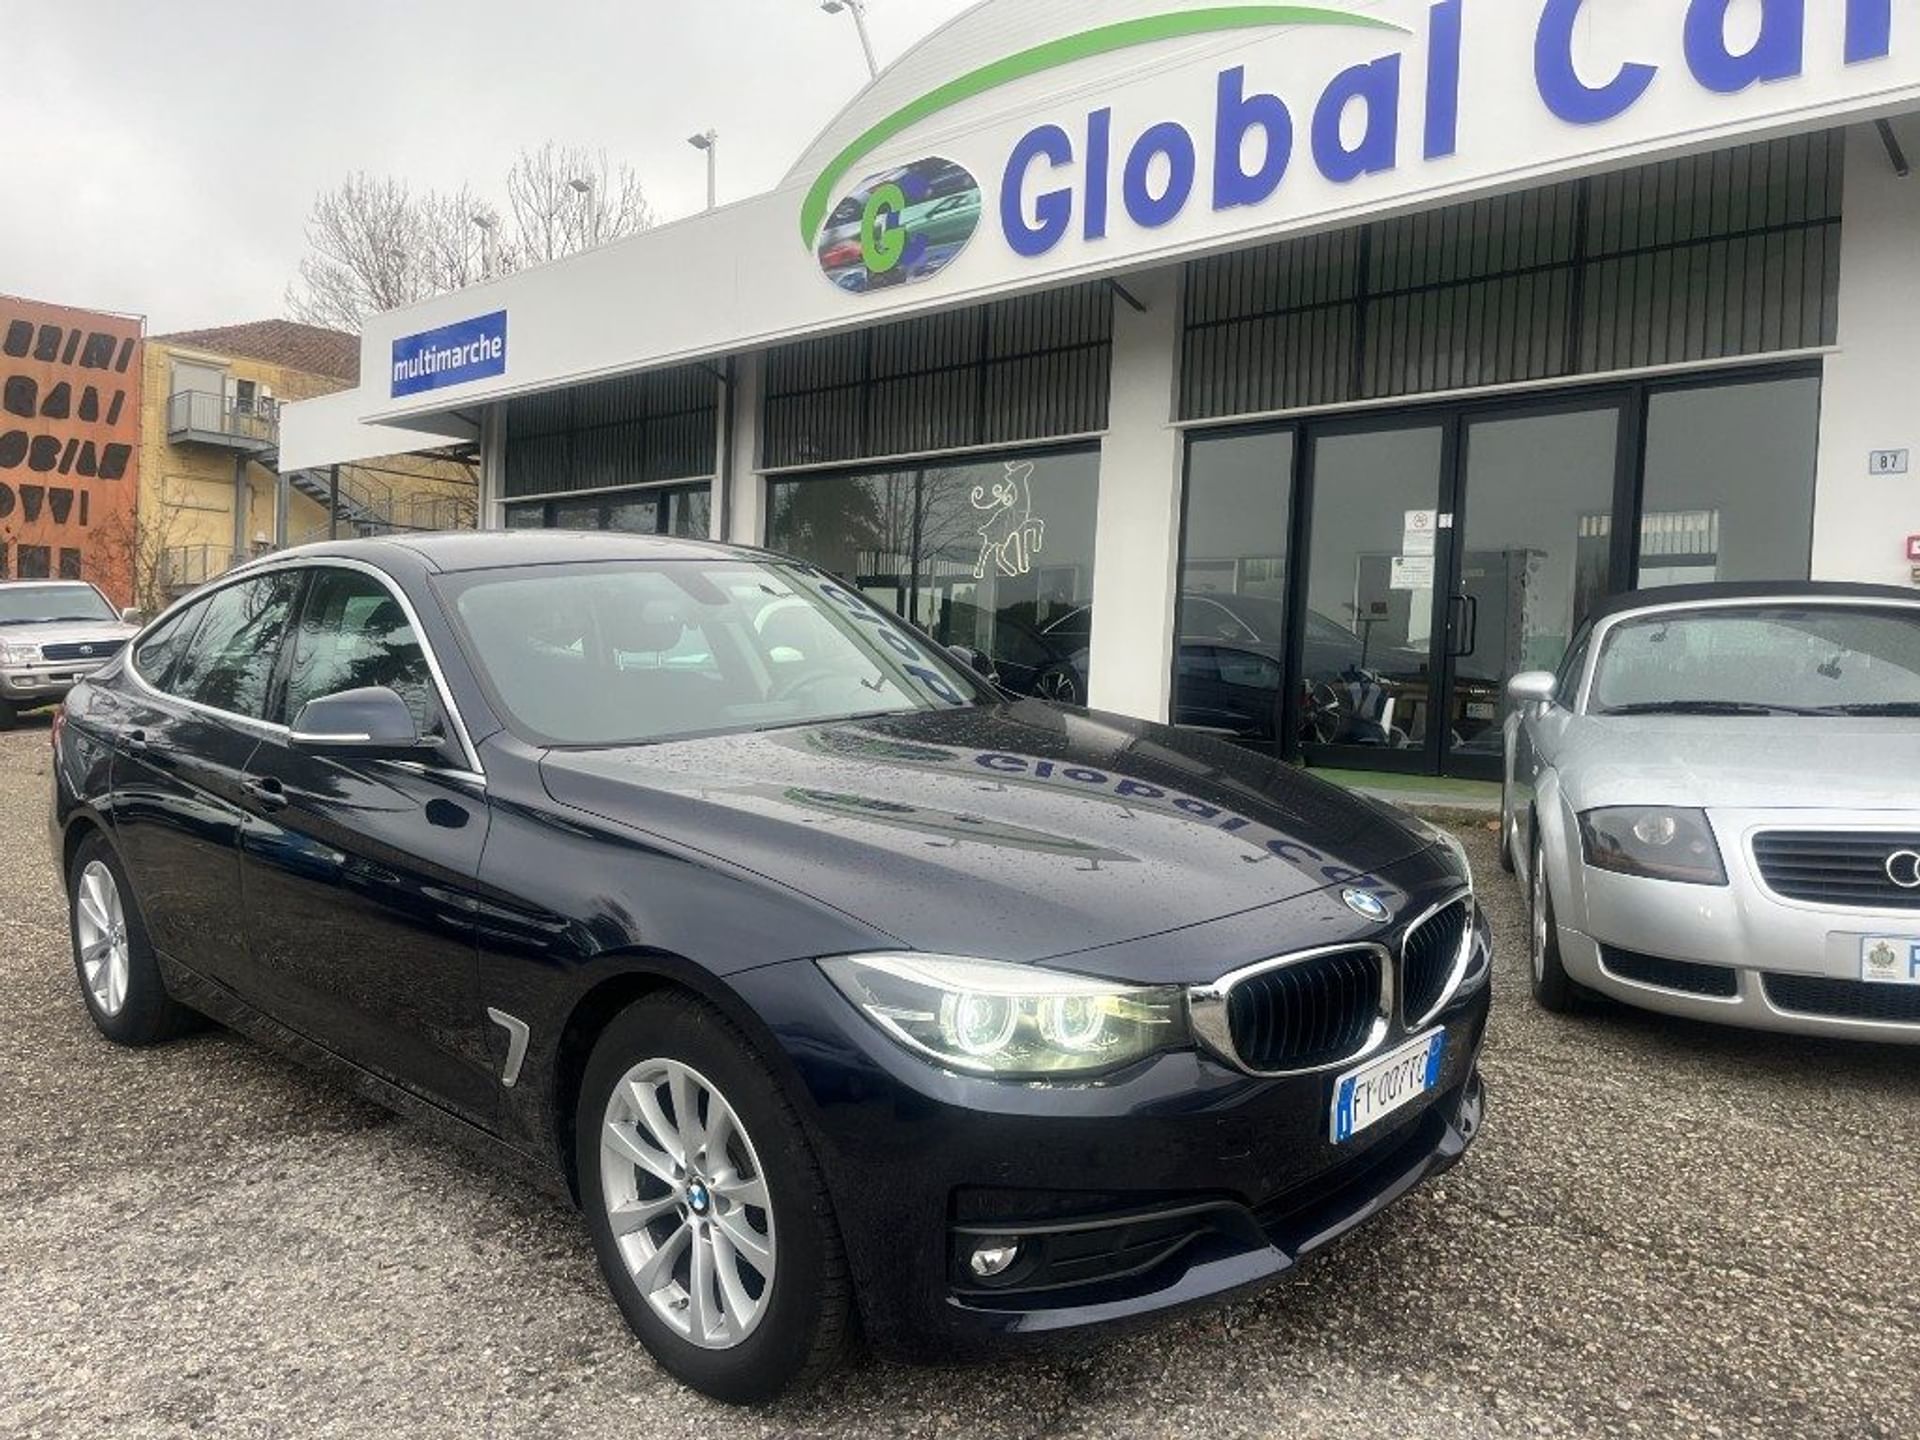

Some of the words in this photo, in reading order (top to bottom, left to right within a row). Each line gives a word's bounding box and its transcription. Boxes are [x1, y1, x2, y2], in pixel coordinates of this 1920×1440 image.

[1000, 0, 1462, 258] Global
[393, 333, 503, 382] multimarche
[1880, 455, 1897, 469] 87
